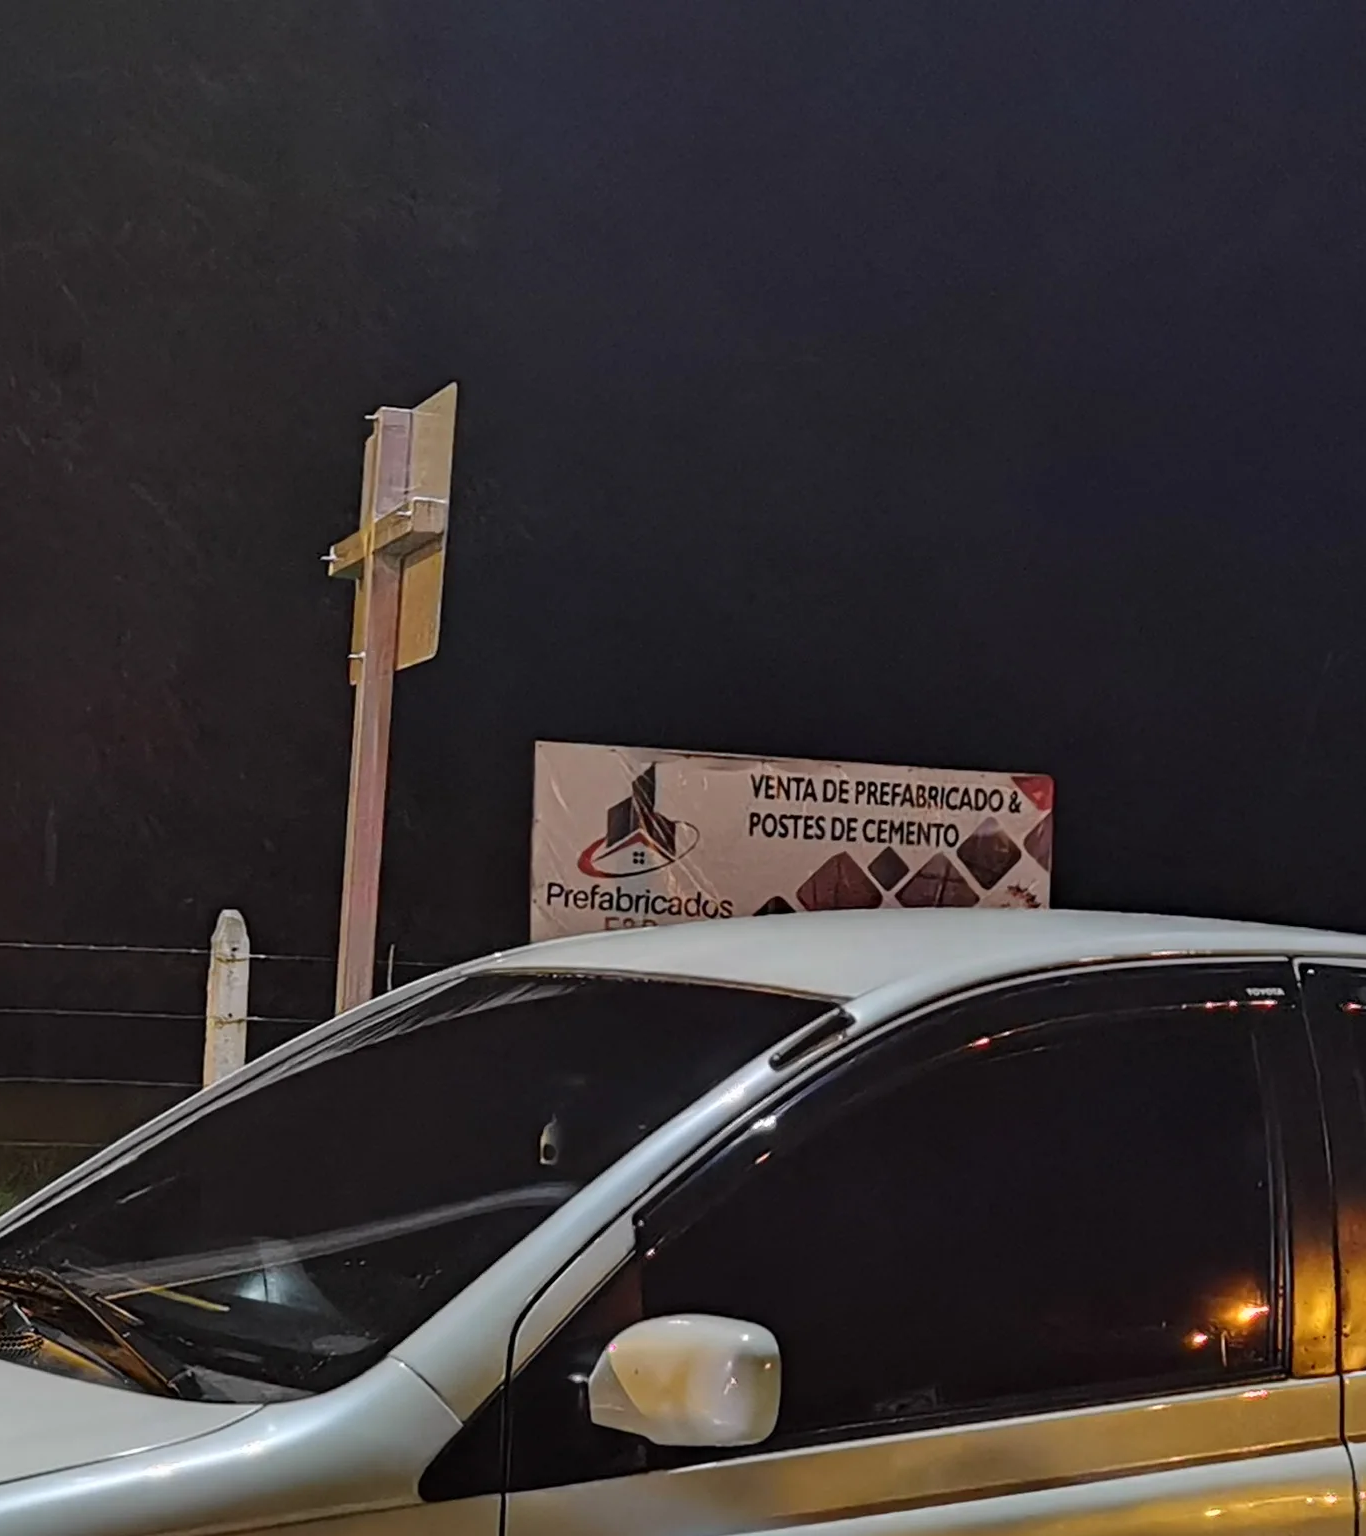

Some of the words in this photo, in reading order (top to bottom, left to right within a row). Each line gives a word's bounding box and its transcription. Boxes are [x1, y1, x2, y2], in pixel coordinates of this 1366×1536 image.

[750, 774, 818, 803] VENTA
[822, 778, 850, 804] DE
[854, 781, 1005, 812] PREFABRICADO
[1008, 790, 1022, 814] &
[749, 812, 826, 840] POSTES
[831, 817, 858, 842] DE
[862, 819, 960, 848] CEMENTO
[547, 883, 734, 919] Prefabricados
